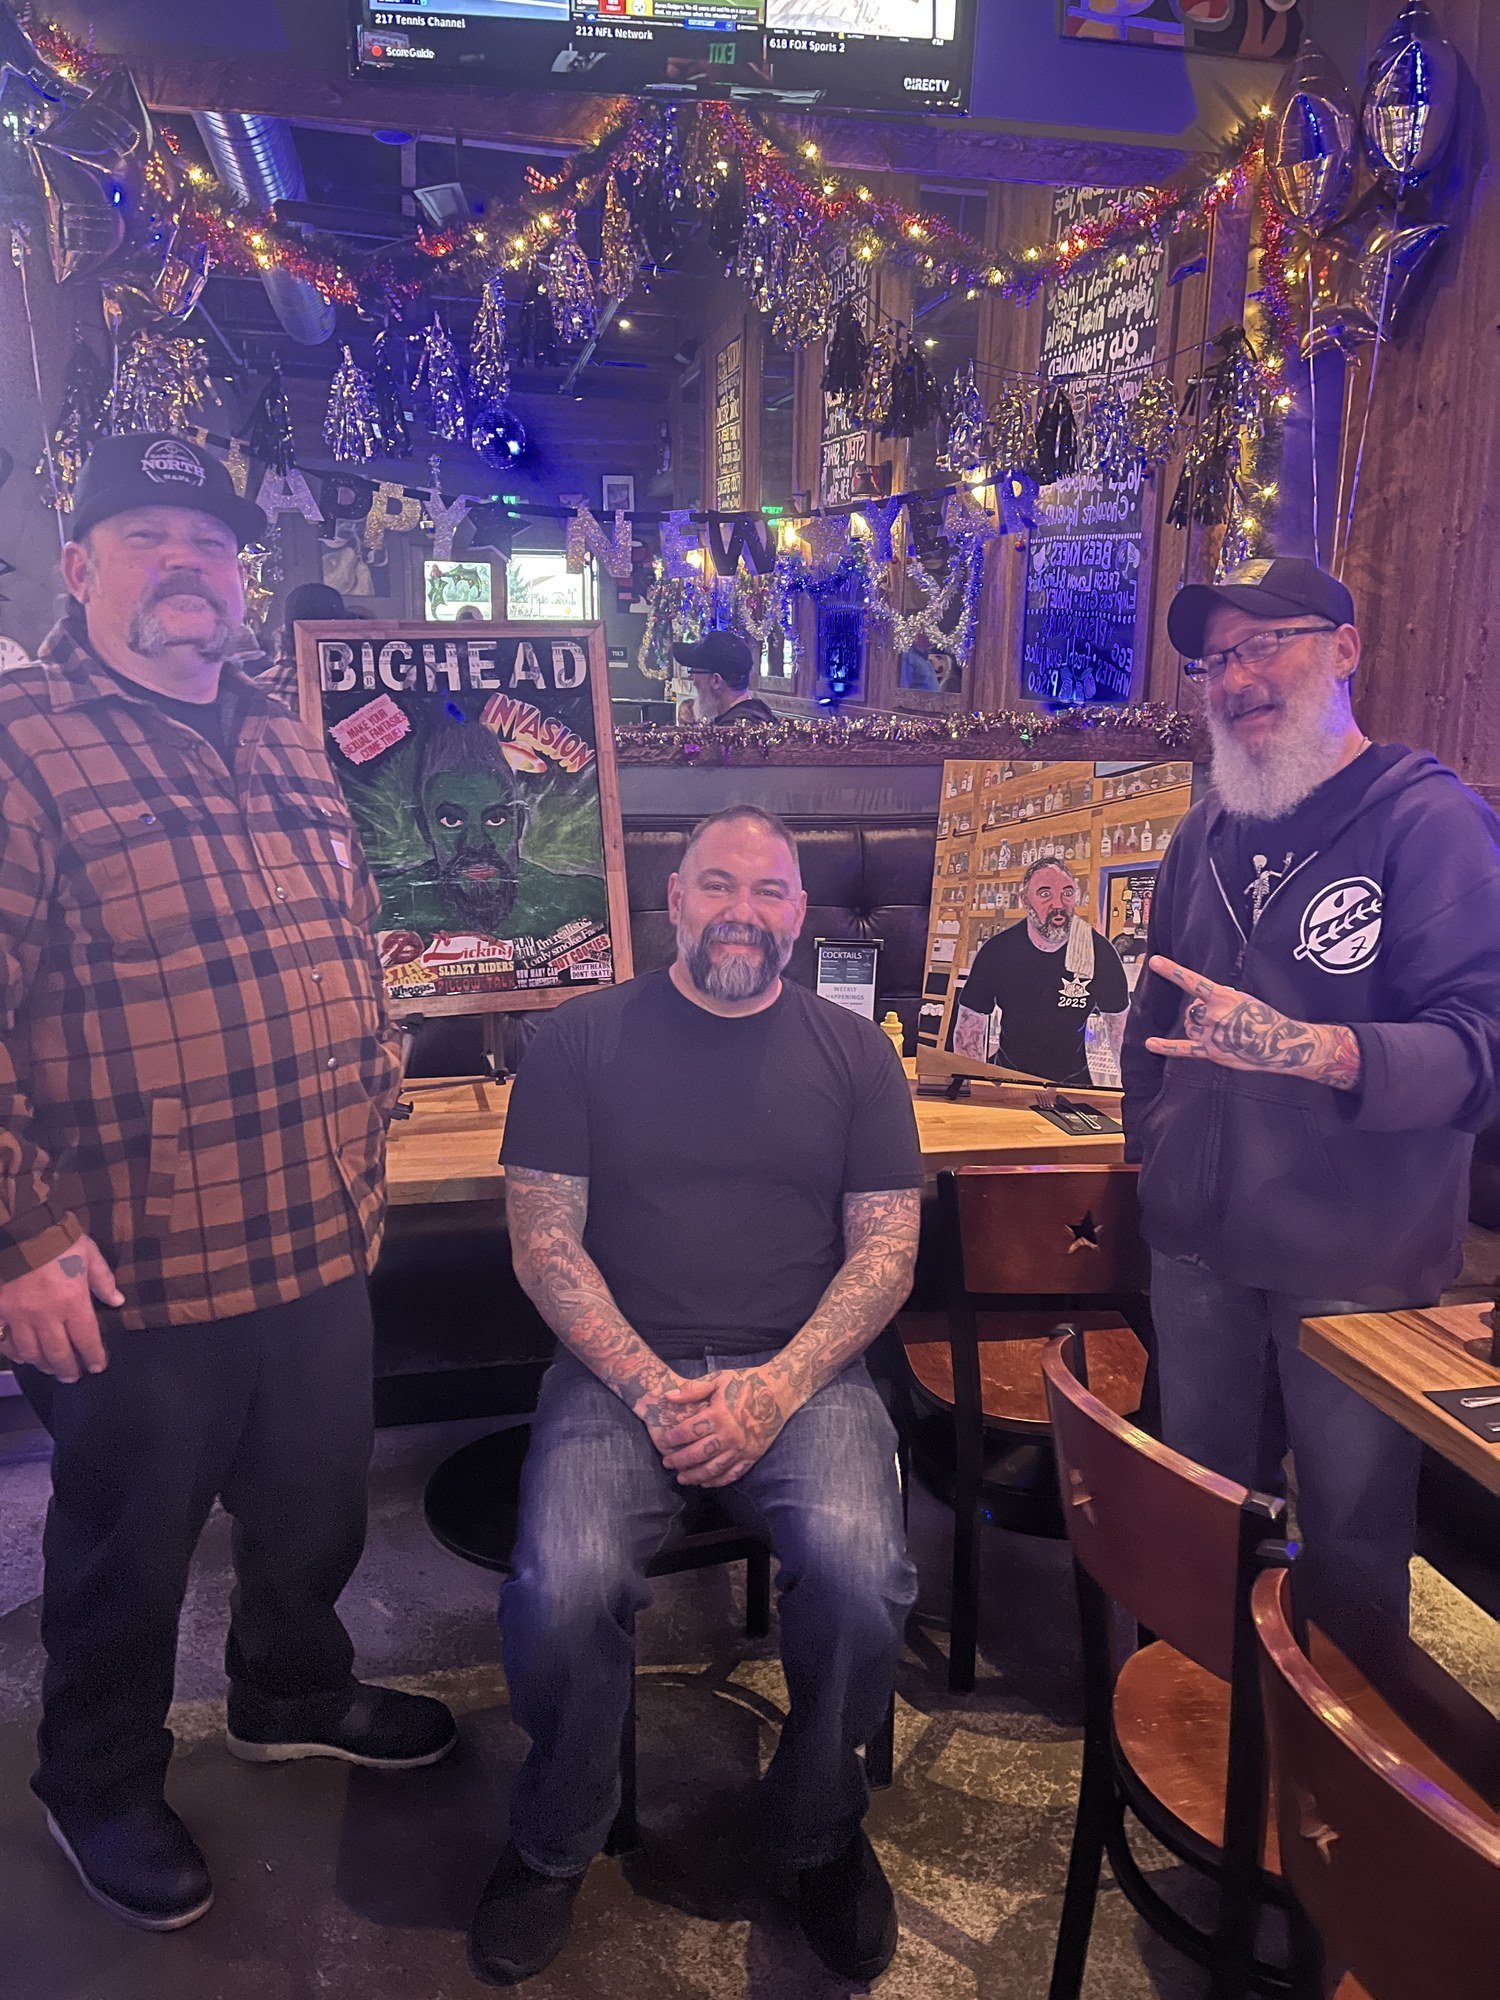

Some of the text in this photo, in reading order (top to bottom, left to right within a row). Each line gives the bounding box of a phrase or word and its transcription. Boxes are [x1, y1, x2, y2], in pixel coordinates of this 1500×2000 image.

[375, 13, 466, 29] 217 Tennis Channel
[575, 25, 654, 41] 212 NFL Network
[769, 37, 846, 53] 618 FOX Sports 2
[902, 76, 950, 93] DIRECTV
[140, 459, 206, 479] NORTH
[317, 640, 588, 692] BIGHEAD
[346, 719, 371, 740] MAKE
[367, 707, 389, 727] YOUR
[484, 692, 596, 773] INVASION
[342, 734, 372, 757] SEXUAL
[368, 710, 407, 740] FANTASIES
[423, 938, 513, 963] Licking
[530, 950, 552, 967] only
[551, 934, 582, 956] smoke
[550, 954, 571, 972] HOT
[570, 935, 609, 960] COOKIES
[822, 951, 863, 960] COCKTAILS
[438, 960, 515, 977] SLEAZY RIDERS
[437, 976, 516, 993] PILLOW TALK
[1057, 996, 1087, 1009] 2025
